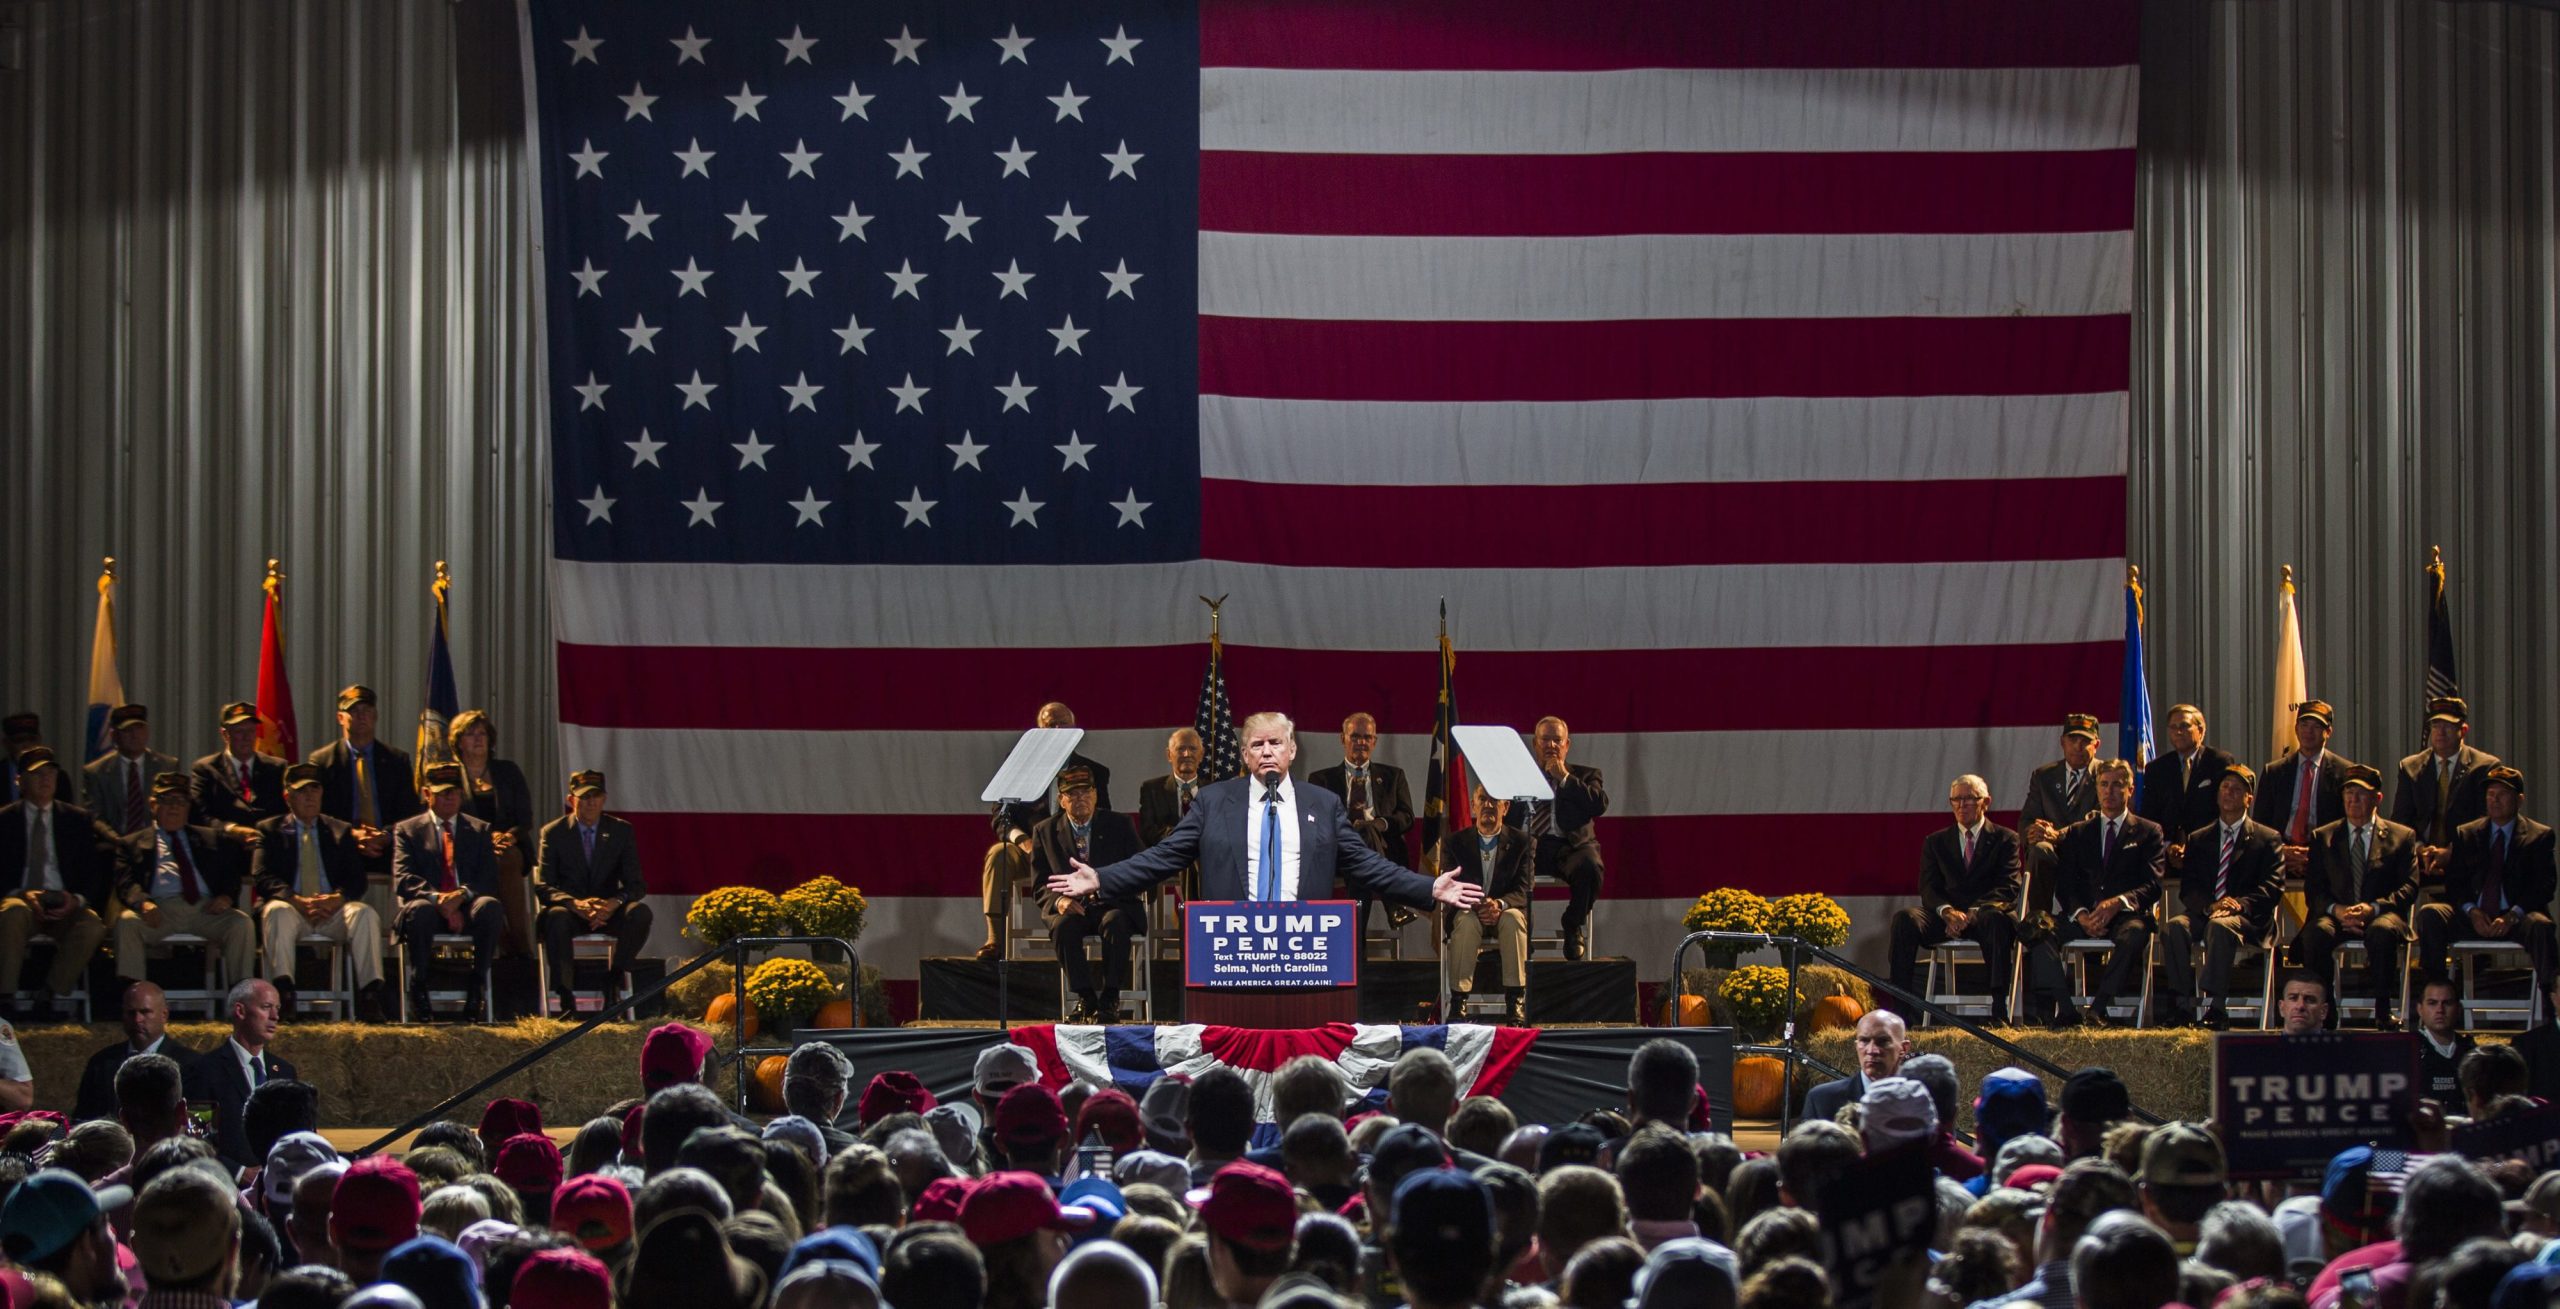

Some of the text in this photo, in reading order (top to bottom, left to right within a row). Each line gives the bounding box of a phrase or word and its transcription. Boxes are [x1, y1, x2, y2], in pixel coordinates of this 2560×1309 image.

[1199, 914, 1342, 934] TRUMP
[1213, 936, 1328, 951] PENCE
[1213, 953, 1233, 961] Text
[1236, 952, 1277, 961] TRUMP
[1293, 952, 1328, 960] 88022
[1214, 963, 1328, 974] Selma, North Carolina
[2229, 1072, 2408, 1103] TRUMP
[2244, 1103, 2391, 1125] PENCE
